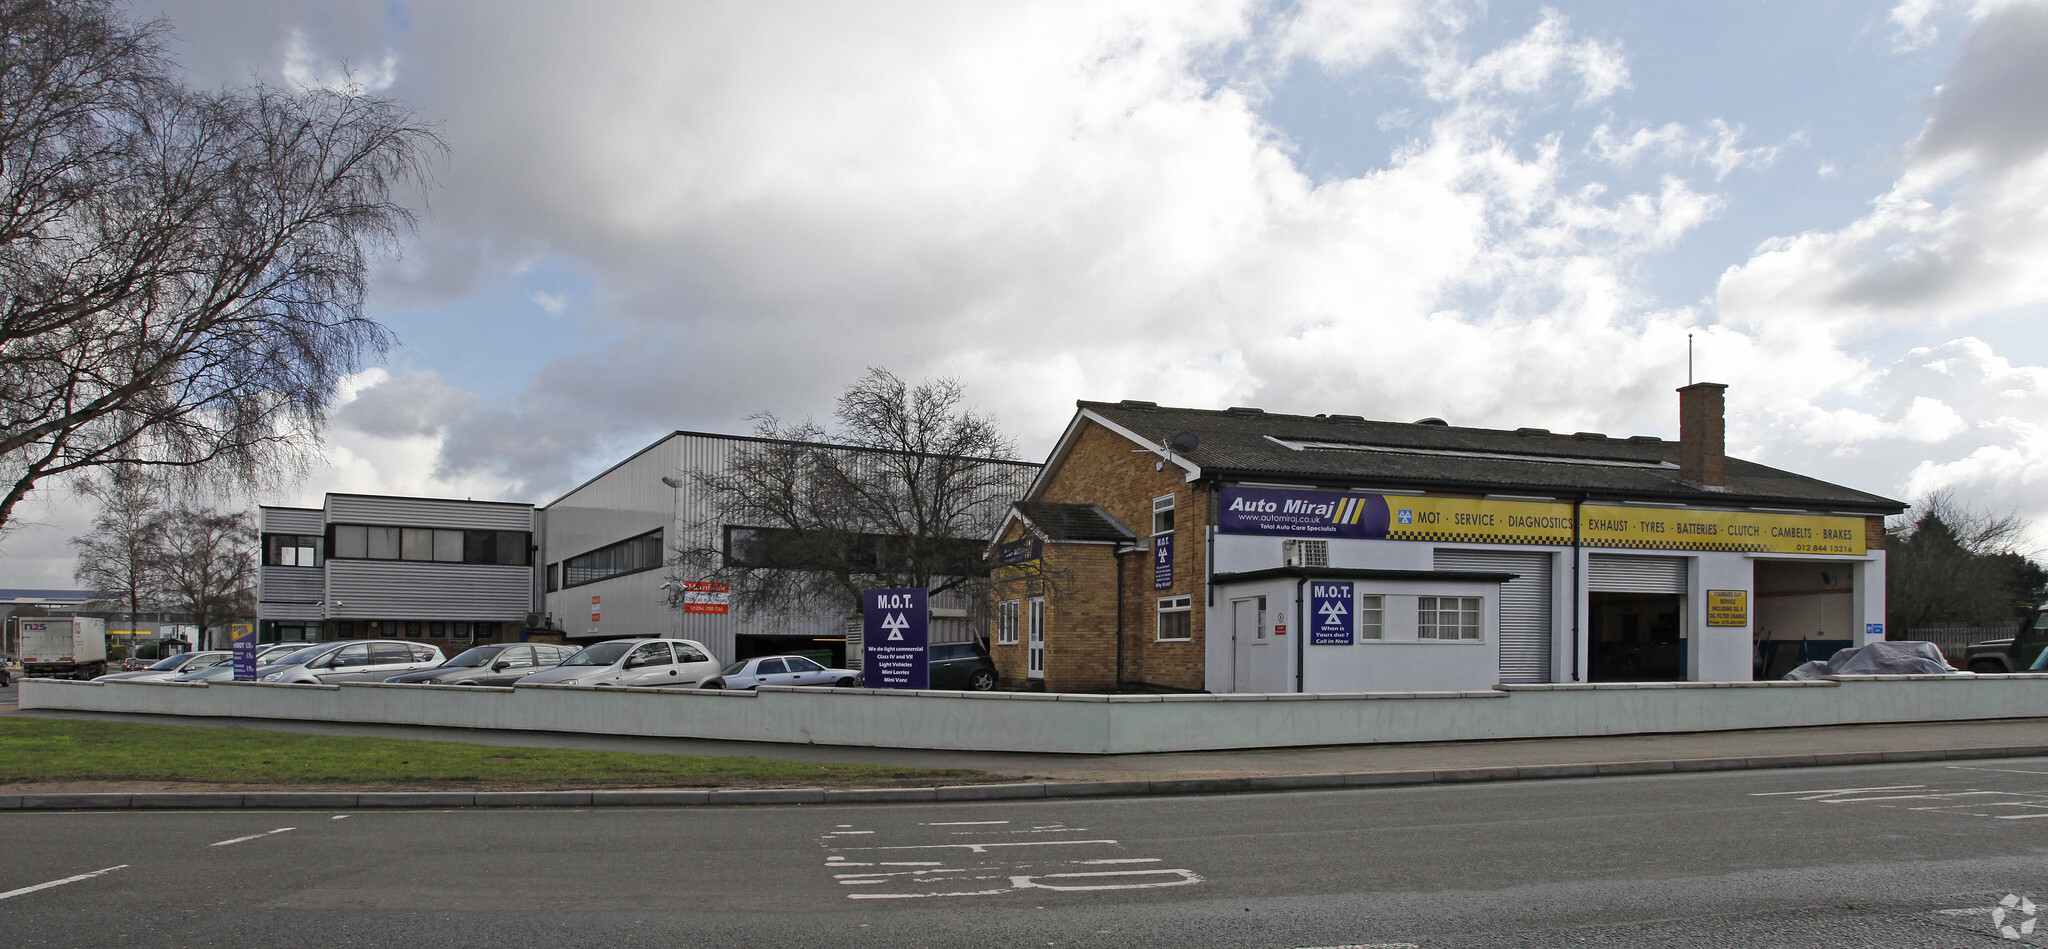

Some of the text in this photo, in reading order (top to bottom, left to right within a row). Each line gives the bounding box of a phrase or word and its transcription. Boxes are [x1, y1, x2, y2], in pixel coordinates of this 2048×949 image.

[1229, 497, 1335, 518] Auto Miraj
[1238, 514, 1320, 524] www.automiraj.co.uk
[1418, 512, 1572, 529] MOT SERVICE DIAGNOSTICS
[1588, 519, 1852, 540] EXHAUST TYRES BATTERIES CLUTCH CAMBELTS BRAKES
[1314, 586, 1350, 598] M.O.T.
[878, 594, 912, 608] M.O.T.
